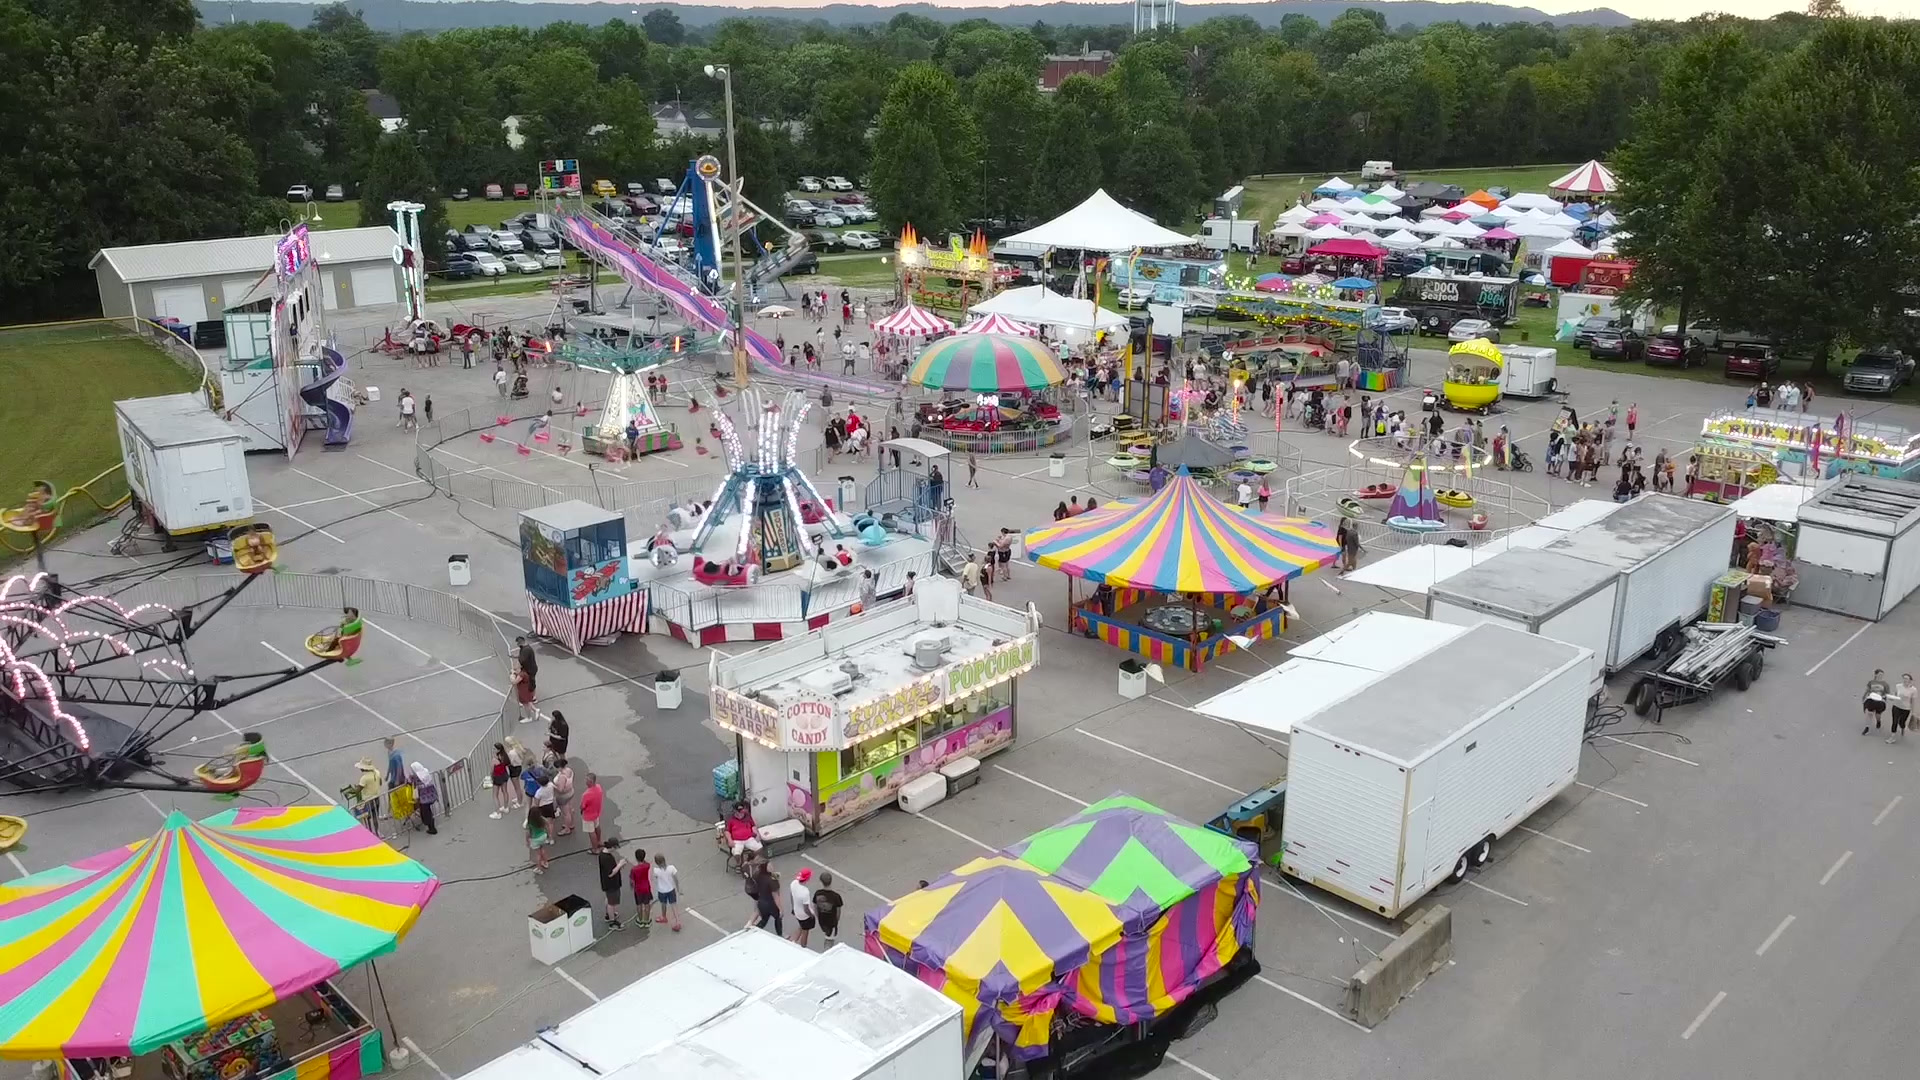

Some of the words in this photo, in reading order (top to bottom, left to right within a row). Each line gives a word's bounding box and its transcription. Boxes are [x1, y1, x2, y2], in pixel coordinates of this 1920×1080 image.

[1420, 291, 1459, 302] Seafood
[1433, 281, 1459, 294] DOCK
[948, 640, 1034, 696] POPCORN
[714, 692, 778, 730] ELEPHANT
[786, 702, 832, 719] COTTON
[850, 681, 934, 724] FUNNEL
[731, 713, 763, 737] EARS
[858, 697, 929, 734] CAKES
[791, 728, 828, 745] CANDY
